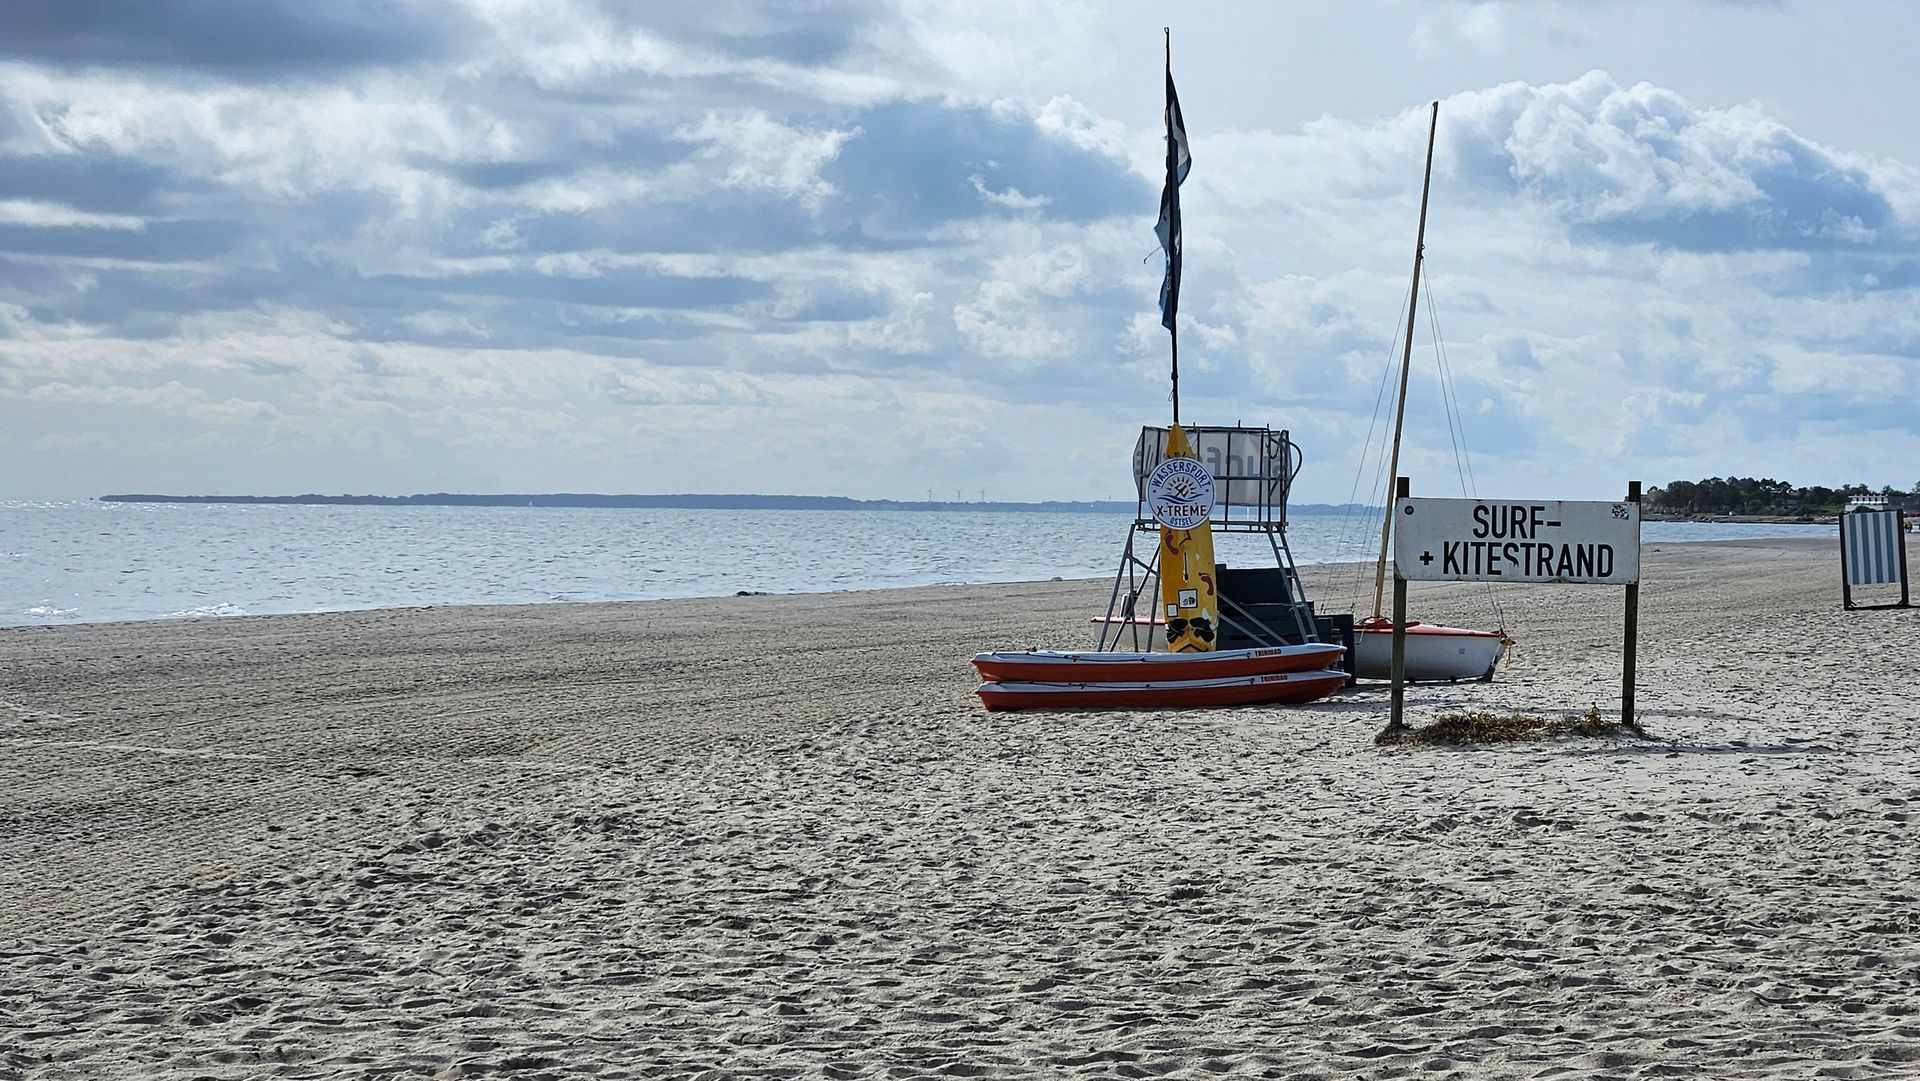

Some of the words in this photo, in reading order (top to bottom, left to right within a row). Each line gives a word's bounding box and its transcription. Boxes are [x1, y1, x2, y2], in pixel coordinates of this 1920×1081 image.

[1151, 461, 1211, 488] WASSERSPORT
[1156, 505, 1207, 517] X-TREME
[1170, 516, 1193, 526] OSTSEE
[1473, 505, 1562, 539] SURF-
[1443, 541, 1614, 578] KITESTRAND
